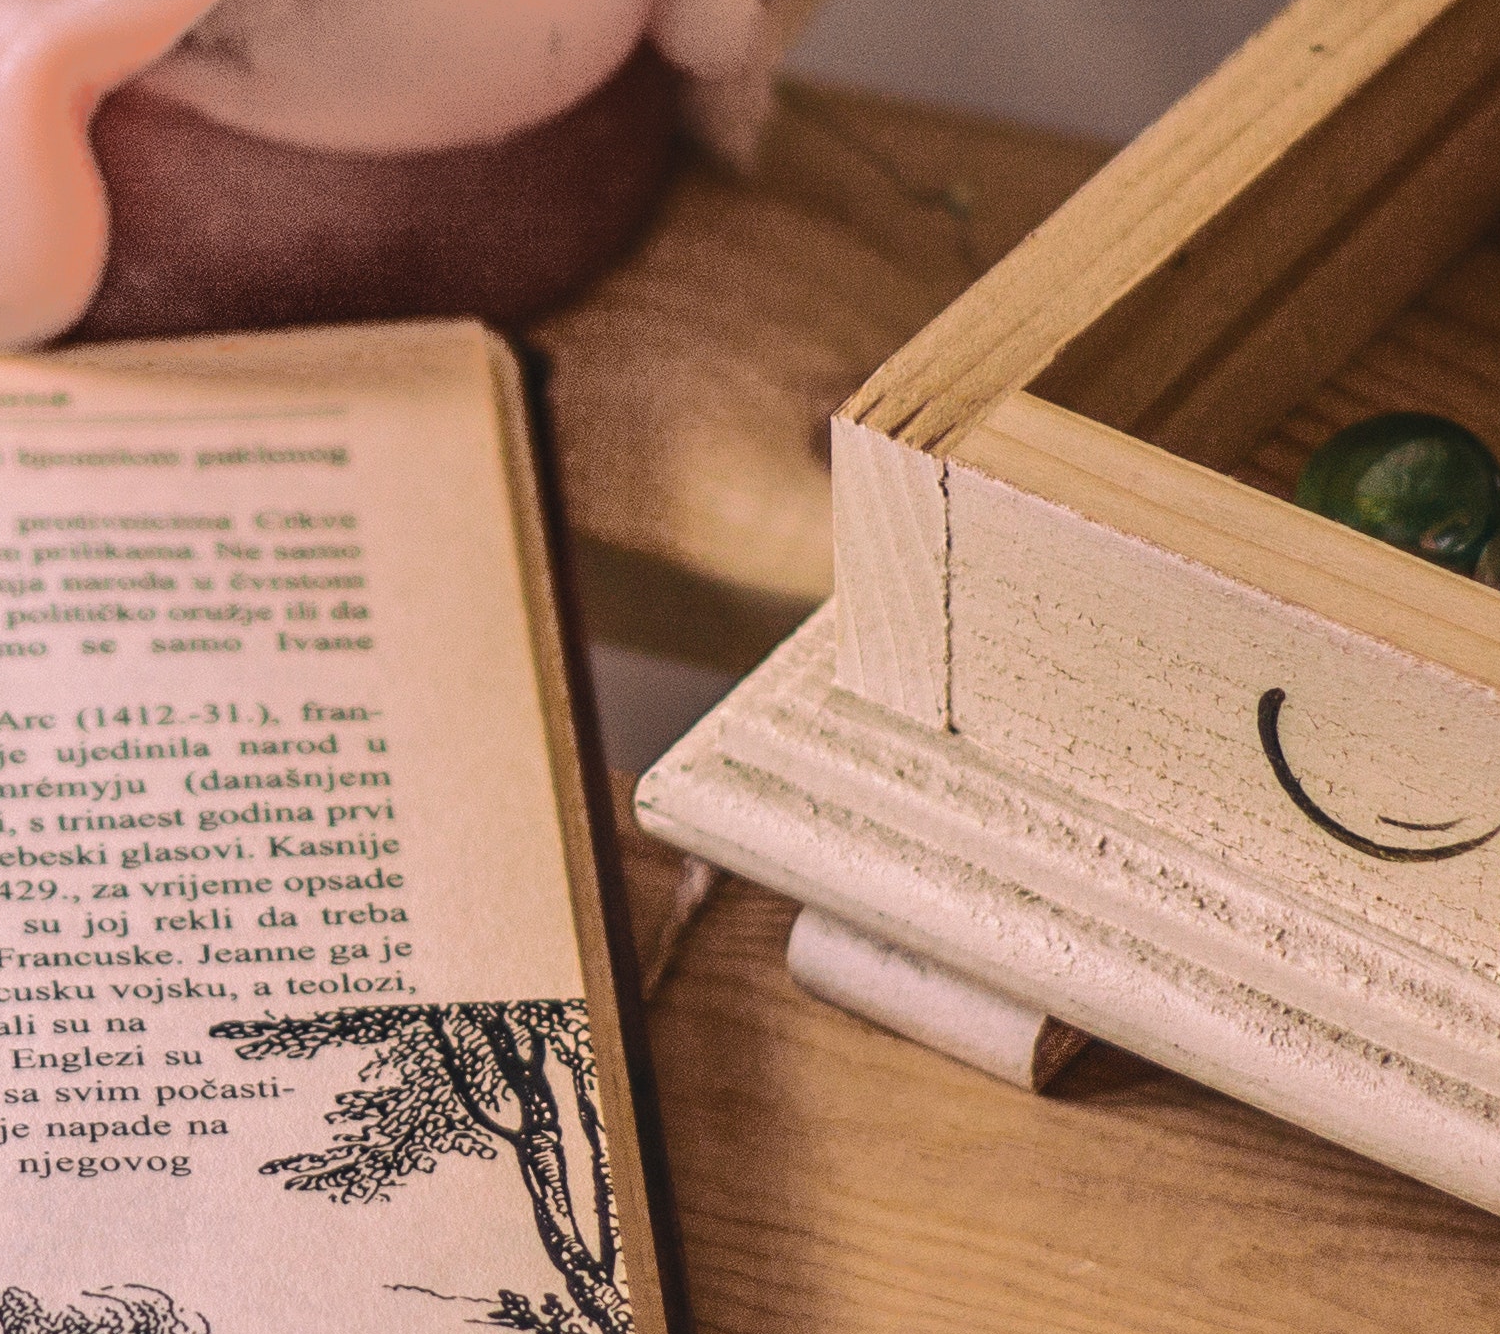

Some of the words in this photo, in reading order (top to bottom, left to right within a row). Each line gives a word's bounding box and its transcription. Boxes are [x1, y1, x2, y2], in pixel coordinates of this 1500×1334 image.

[79, 640, 118, 655] se
[148, 637, 244, 654] samo
[275, 628, 376, 652] Ivane
[299, 699, 382, 723] fran-
[54, 735, 213, 769] ujedinila
[237, 729, 341, 756] narod
[365, 736, 390, 751] u
[182, 763, 393, 800] (današnjem
[28, 818, 46, 833] s
[55, 807, 186, 832] trinaest
[196, 801, 317, 833] godina
[325, 795, 397, 828] prvi
[119, 836, 255, 871] glasovi.
[267, 830, 401, 860] Kasnije
[91, 884, 131, 900] za
[139, 873, 274, 903] vrijeme
[282, 865, 405, 898] opsade
[22, 920, 62, 936] su
[81, 909, 131, 940] joj
[153, 906, 235, 932] rekli
[255, 904, 300, 928] da
[320, 899, 410, 926] treba
[197, 940, 317, 964] Jeanne
[328, 947, 371, 968] ga
[378, 937, 413, 967] je
[109, 974, 239, 1005] vojsku,
[252, 981, 274, 996] a
[285, 968, 418, 997] teolozi,
[51, 1019, 92, 1035] su
[104, 1017, 148, 1033] na
[11, 1043, 146, 1075] Englezi
[163, 1051, 204, 1066] su
[2, 1089, 41, 1105] sa
[54, 1078, 142, 1103] svim
[154, 1074, 295, 1107] počasti-
[45, 1112, 172, 1144] napade
[186, 1118, 230, 1134] na
[17, 1150, 193, 1180] njegovog
